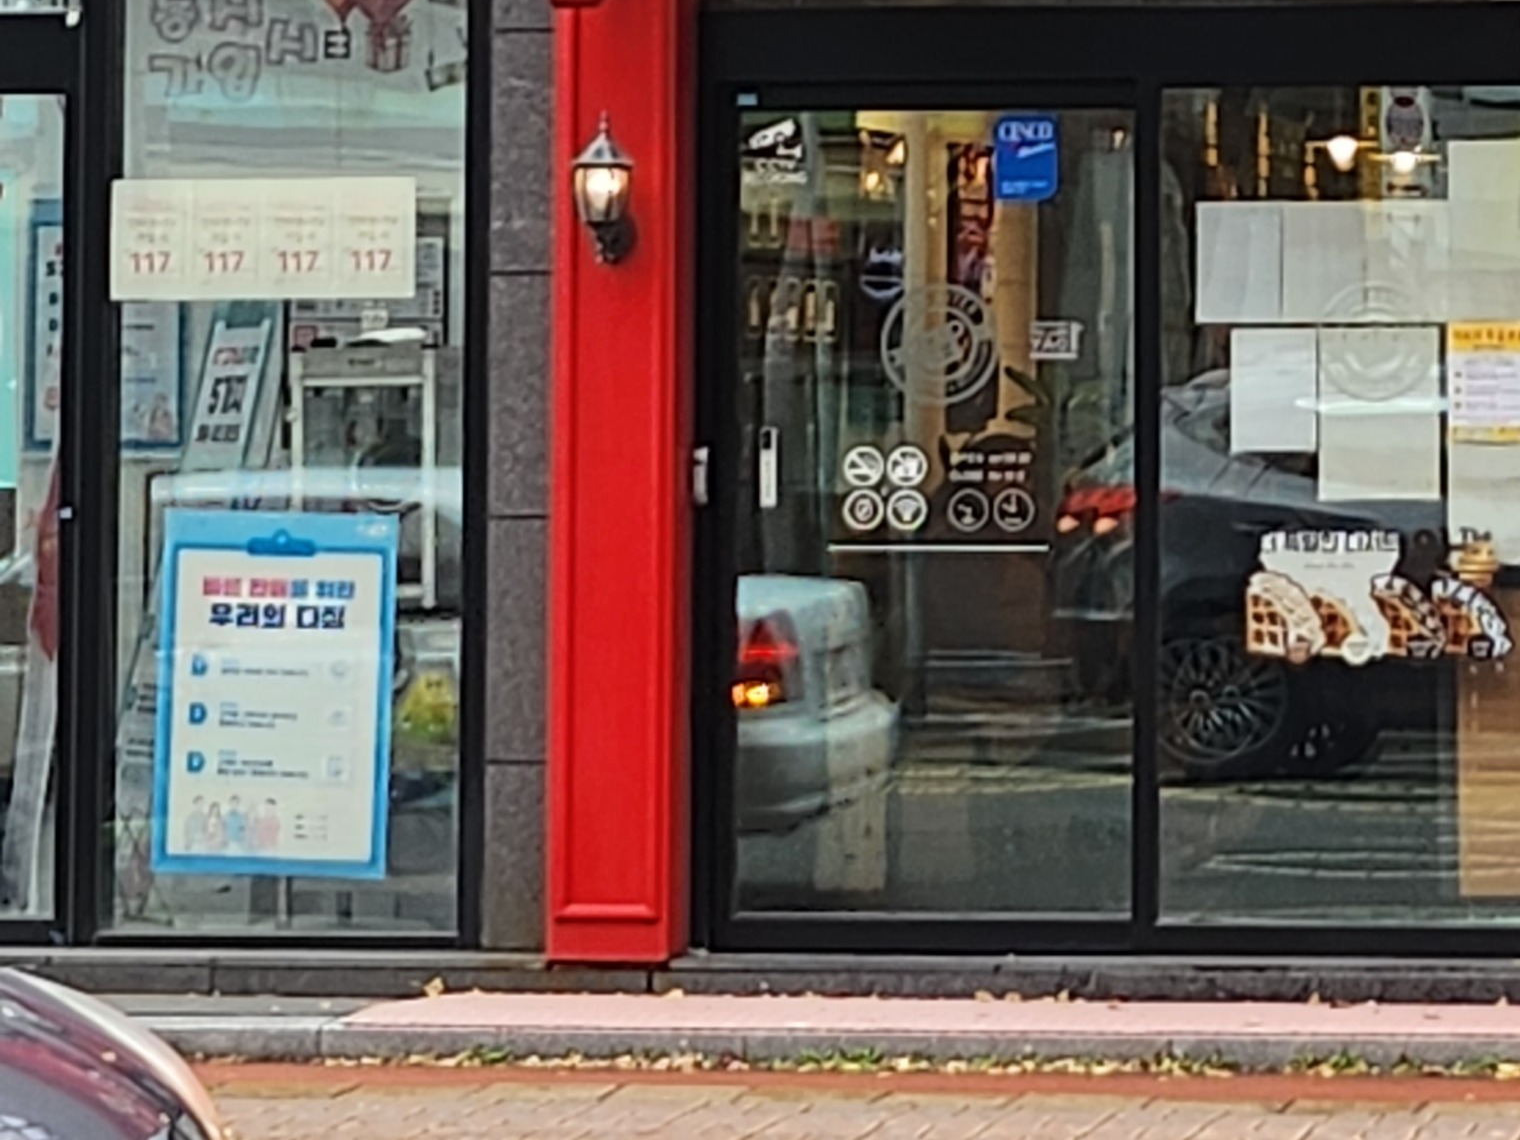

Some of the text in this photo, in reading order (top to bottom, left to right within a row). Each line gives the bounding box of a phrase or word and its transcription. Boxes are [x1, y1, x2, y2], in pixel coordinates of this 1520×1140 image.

[129, 251, 172, 274] 117
[203, 251, 245, 274] 117
[276, 250, 319, 273] 117
[350, 249, 392, 272] 117
[209, 602, 287, 629] 우리의
